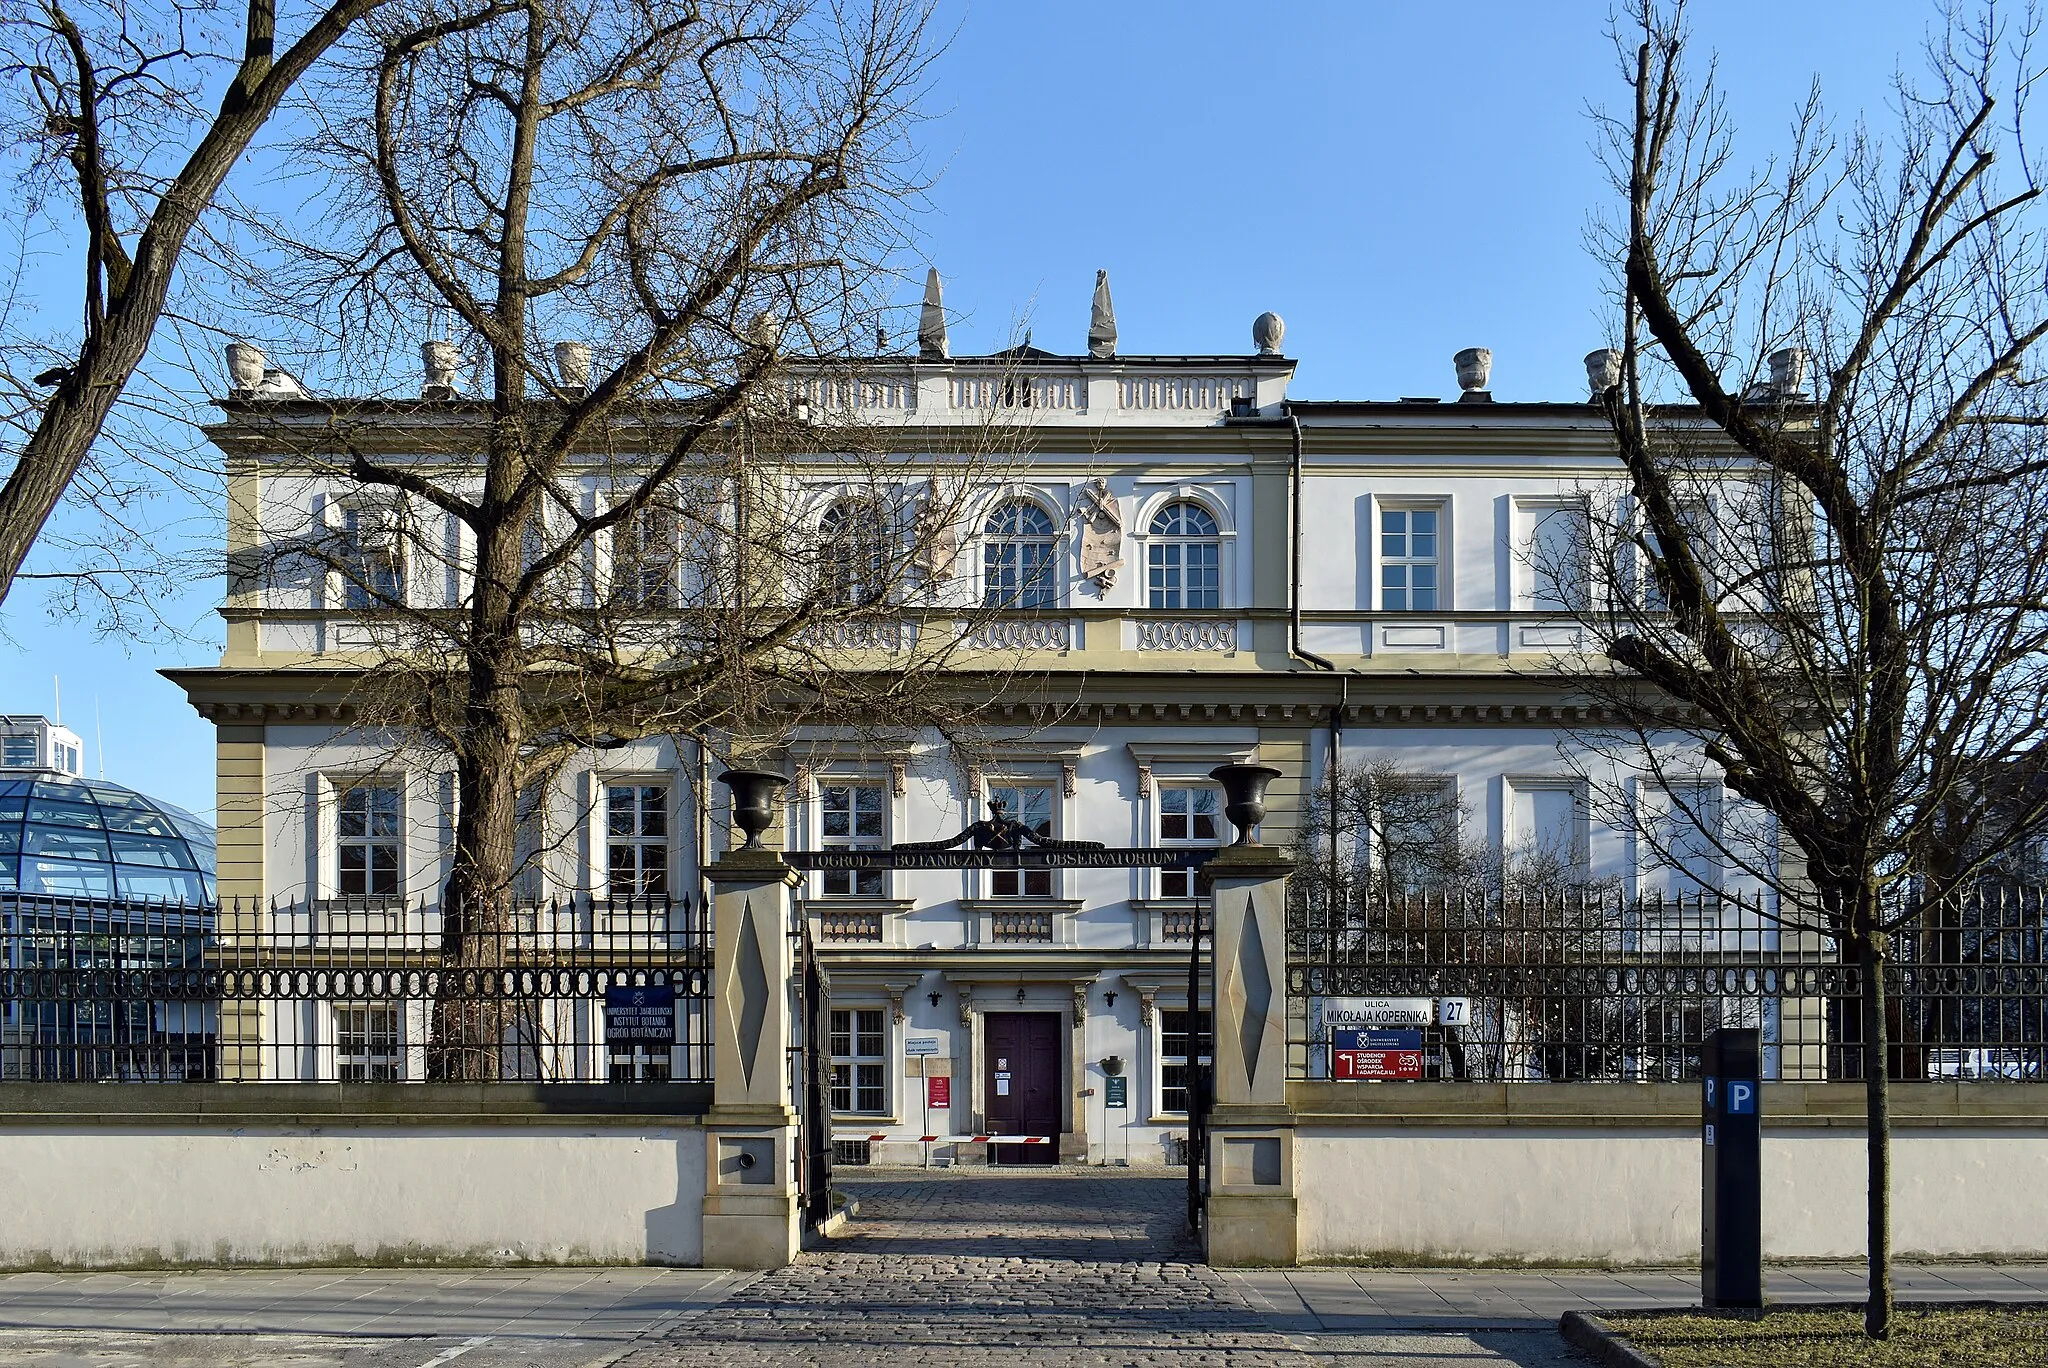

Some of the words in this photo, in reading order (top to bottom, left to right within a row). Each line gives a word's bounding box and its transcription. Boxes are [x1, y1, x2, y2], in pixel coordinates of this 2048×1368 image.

[895, 854, 995, 867] BOTANICZNY
[1046, 852, 1177, 866] OBSERVATORIUM
[607, 1007, 638, 1015] UNIWERSYTET
[1326, 1010, 1372, 1023] MIKOŁAJA
[1375, 1010, 1428, 1022] KOPERNIKA
[1446, 1002, 1463, 1020] 27
[613, 1016, 639, 1026] INSTYTUT
[641, 1016, 666, 1026] BOTANIKI
[607, 1026, 629, 1038] OGRÓD
[631, 1027, 673, 1038] BOTANICZNY
[1707, 1079, 1714, 1102] P
[1734, 1085, 1750, 1110] P
